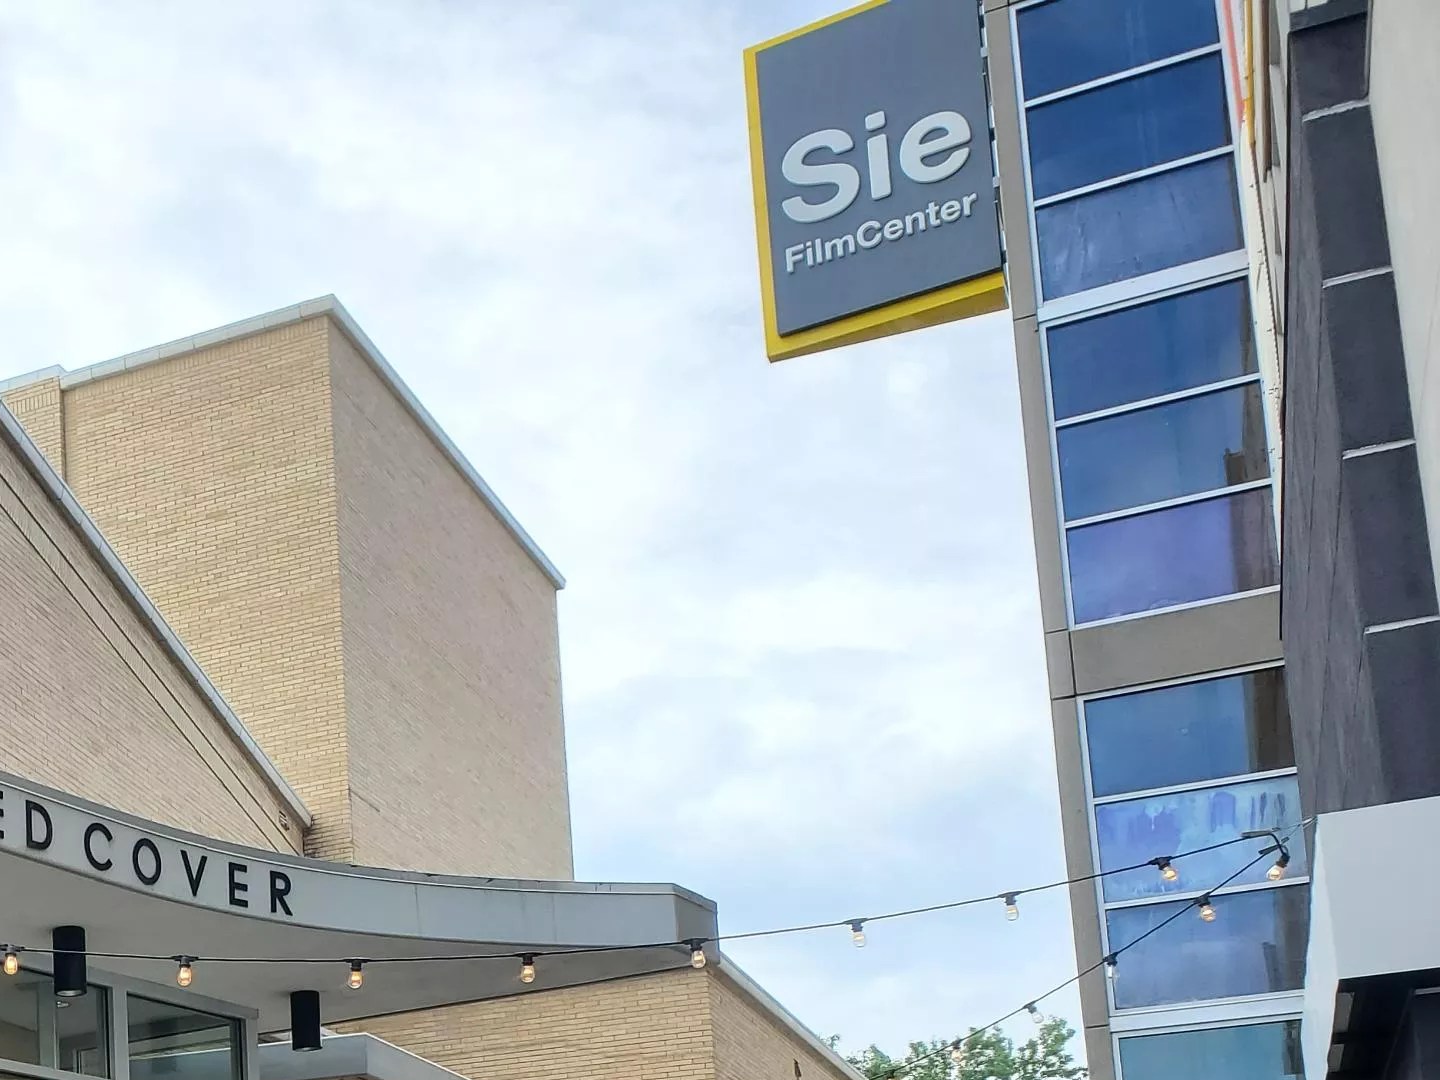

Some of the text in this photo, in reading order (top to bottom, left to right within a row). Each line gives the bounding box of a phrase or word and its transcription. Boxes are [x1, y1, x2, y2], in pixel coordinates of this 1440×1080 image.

[781, 110, 972, 224] Sie
[785, 193, 978, 273] FilmCenter
[83, 822, 294, 916] COVER
